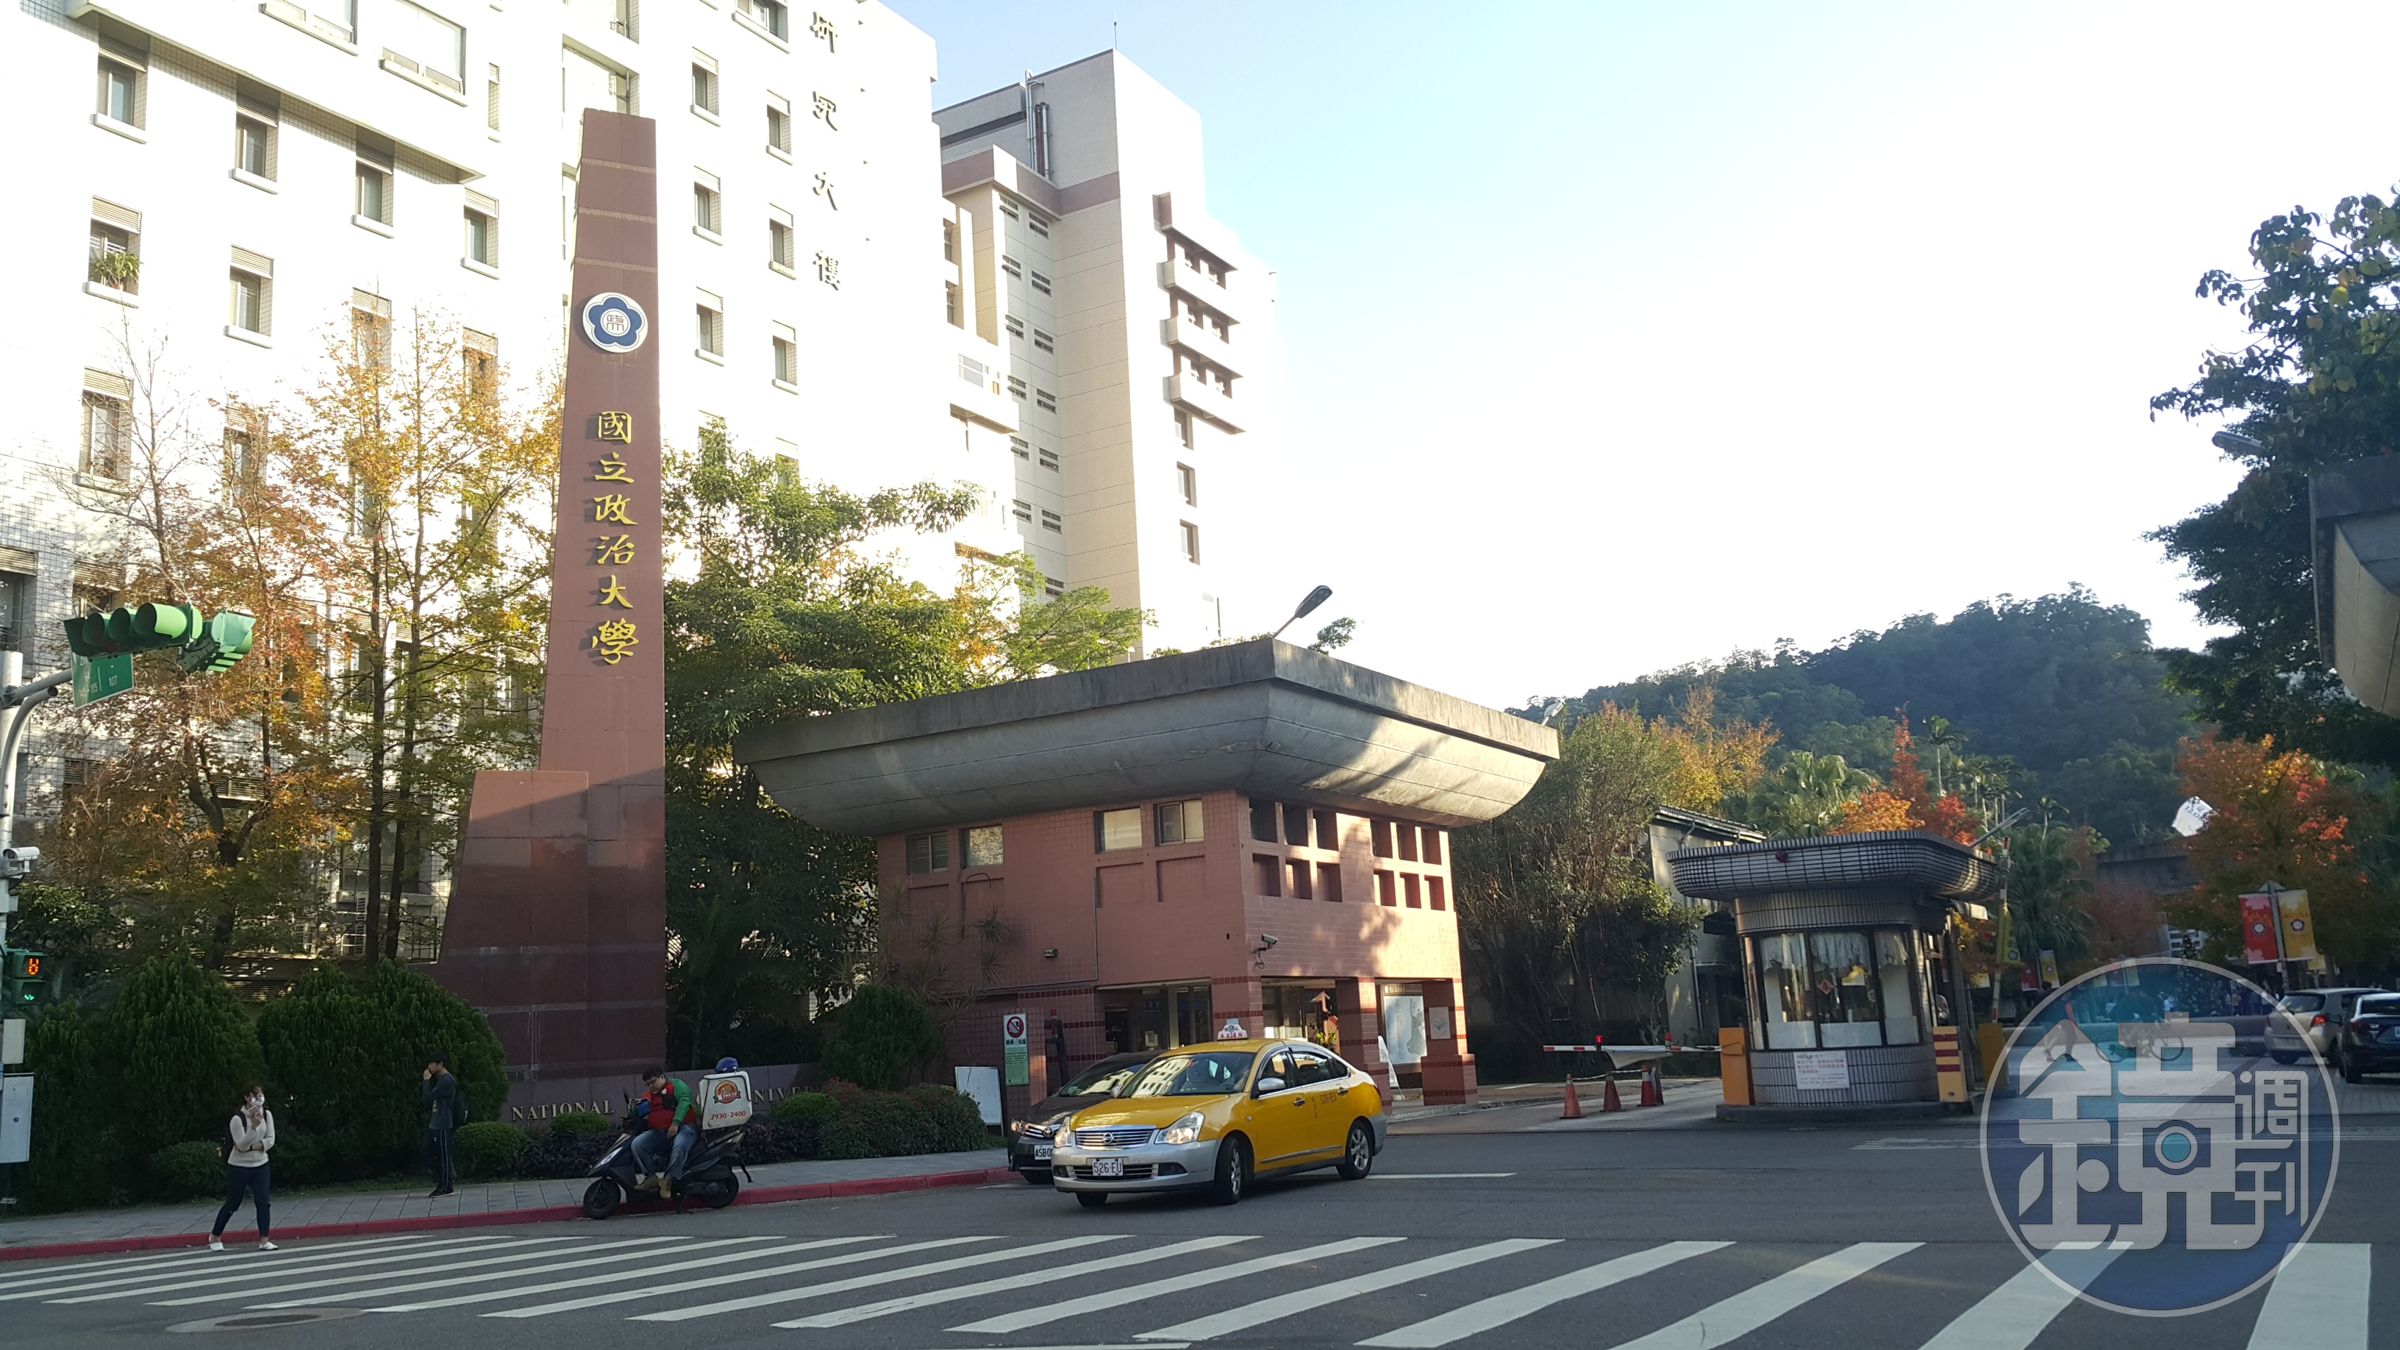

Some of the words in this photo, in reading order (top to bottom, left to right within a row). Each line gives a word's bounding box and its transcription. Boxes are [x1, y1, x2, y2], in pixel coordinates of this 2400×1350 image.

[592, 410, 639, 666] 國立政治大學
[511, 1099, 615, 1121] NATIONAL
